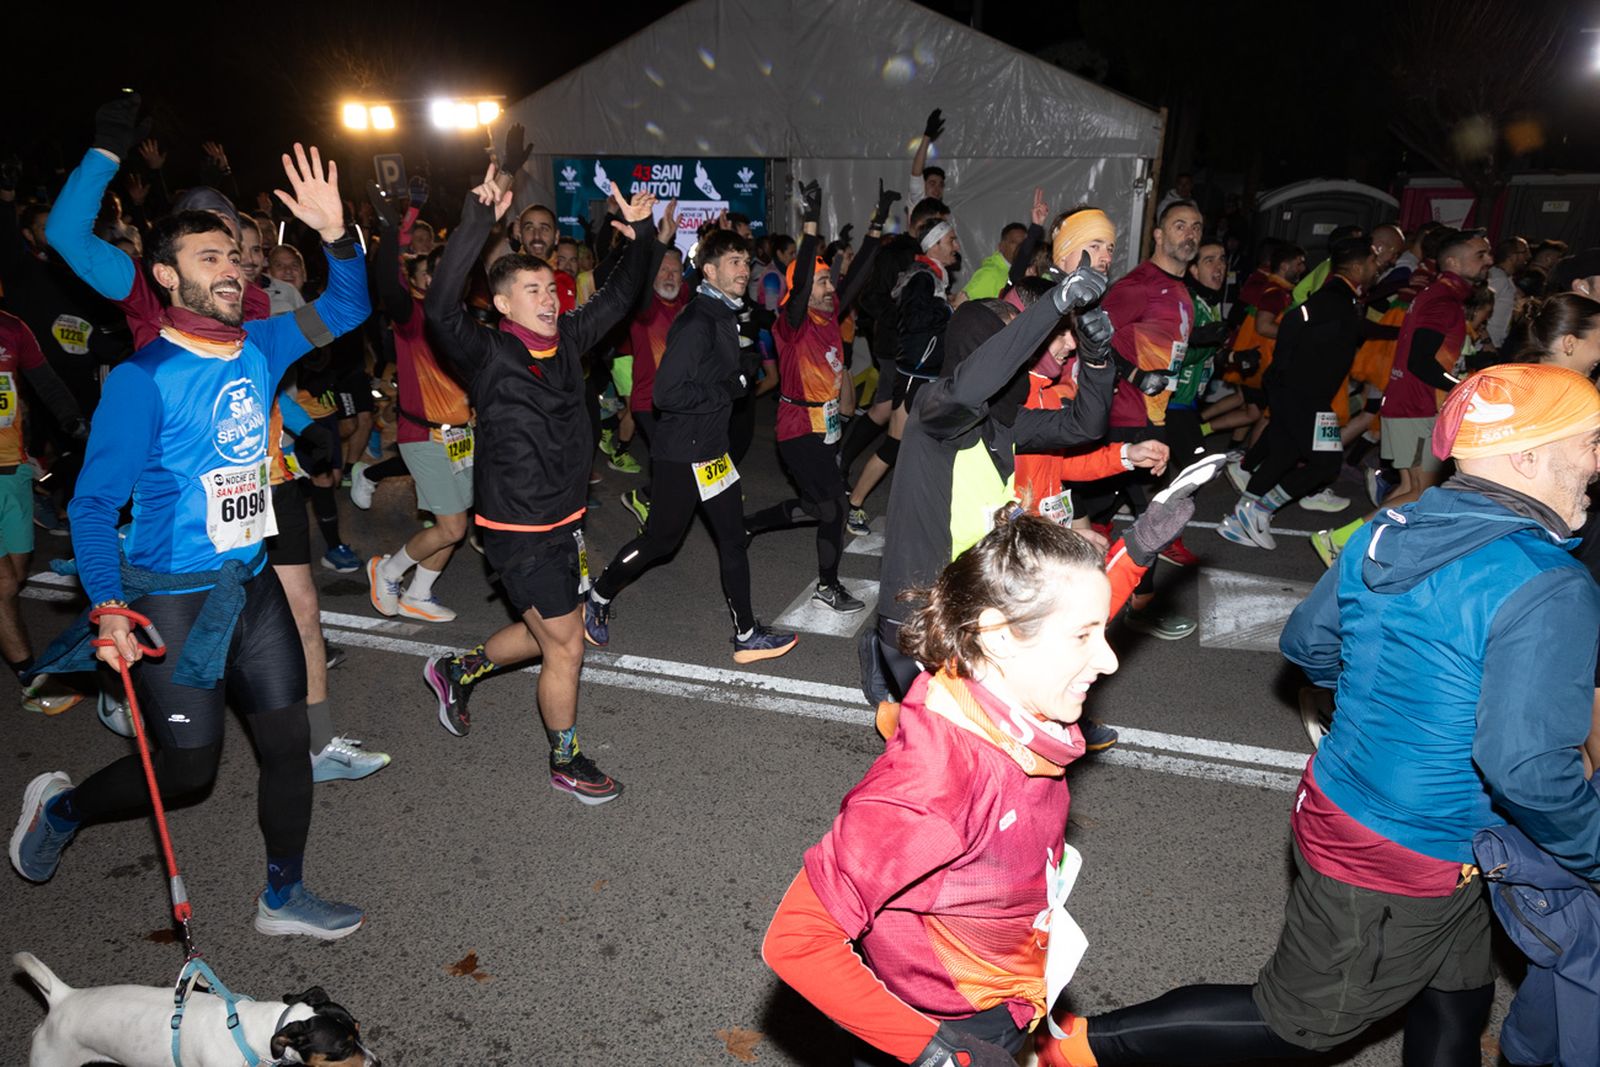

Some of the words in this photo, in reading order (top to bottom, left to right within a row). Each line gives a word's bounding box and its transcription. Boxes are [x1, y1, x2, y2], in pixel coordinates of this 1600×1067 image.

[382, 160, 400, 187] P
[216, 488, 233, 498] SAN
[222, 489, 266, 523] 6098
